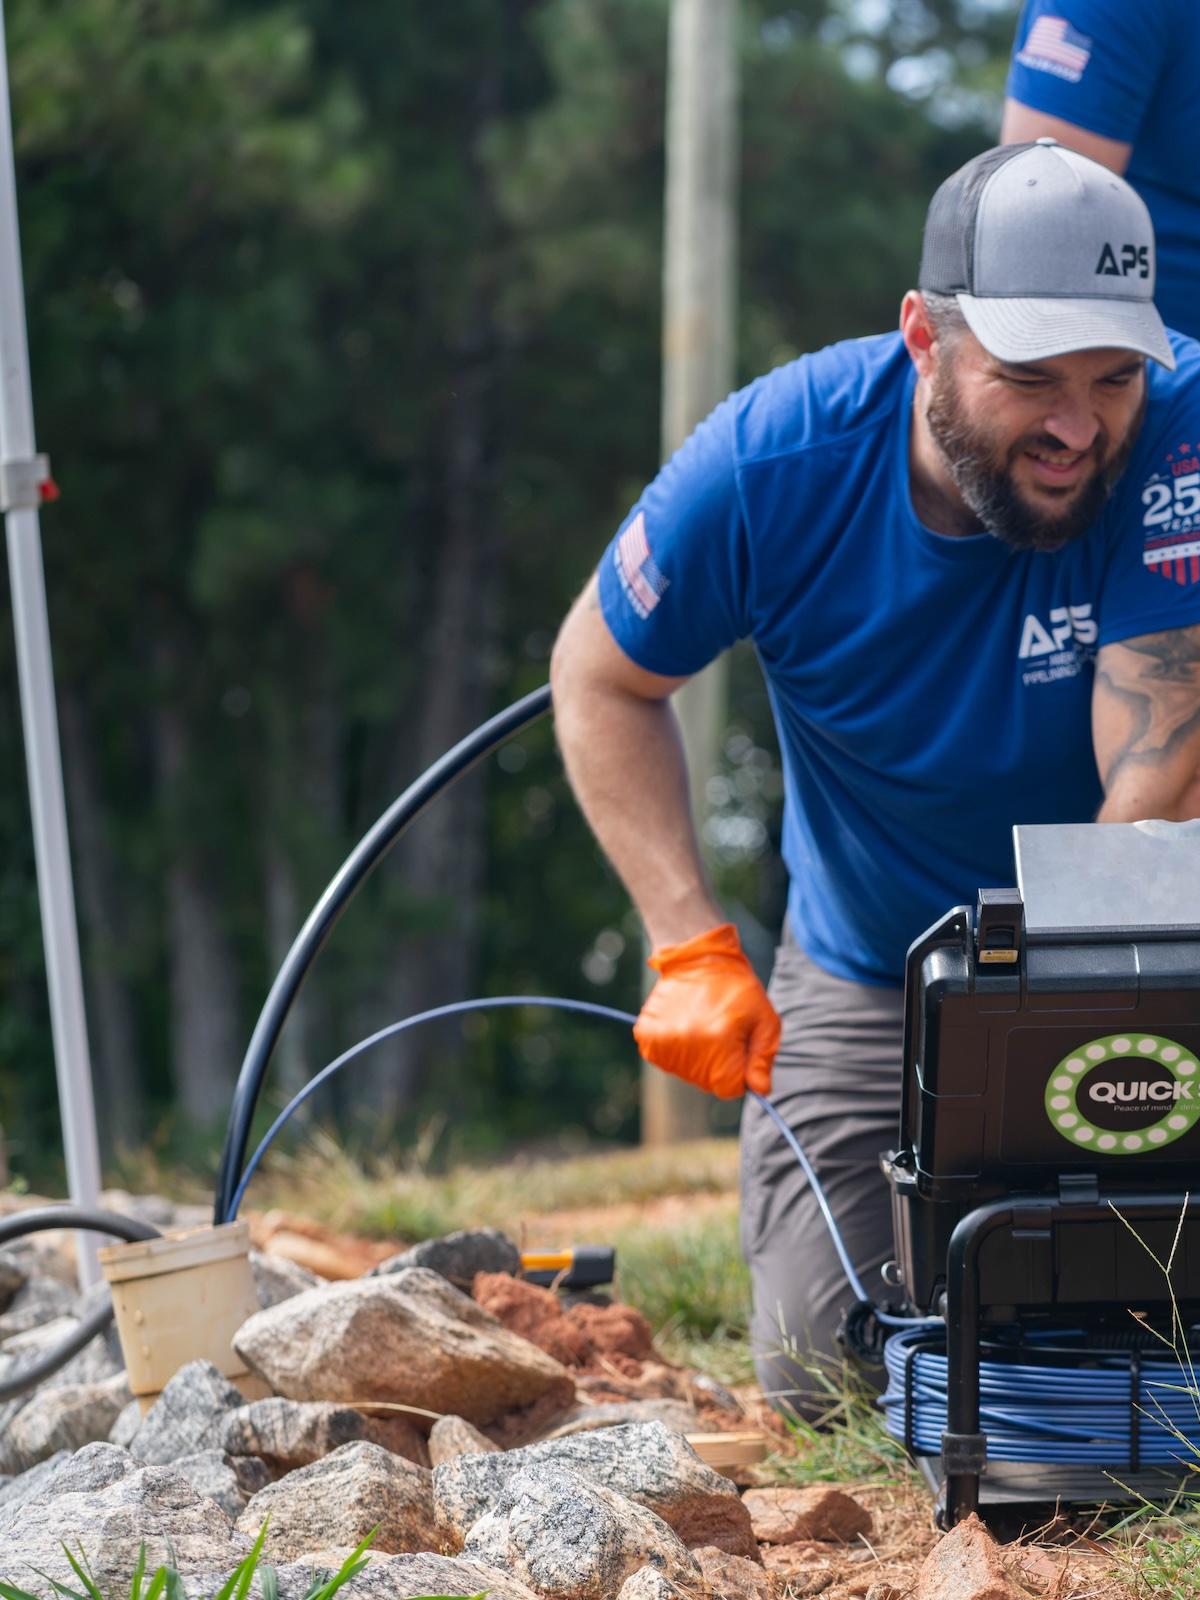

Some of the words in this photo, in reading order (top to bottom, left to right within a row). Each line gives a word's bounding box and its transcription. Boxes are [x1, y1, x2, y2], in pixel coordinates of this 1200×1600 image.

[1095, 243, 1150, 279] APS
[1171, 457, 1200, 476] USA
[1018, 603, 1099, 659] APS
[1089, 1080, 1194, 1104] QUICK
[1114, 1104, 1140, 1112] Peace
[1141, 1104, 1150, 1112] of
[1151, 1104, 1172, 1112] mind
